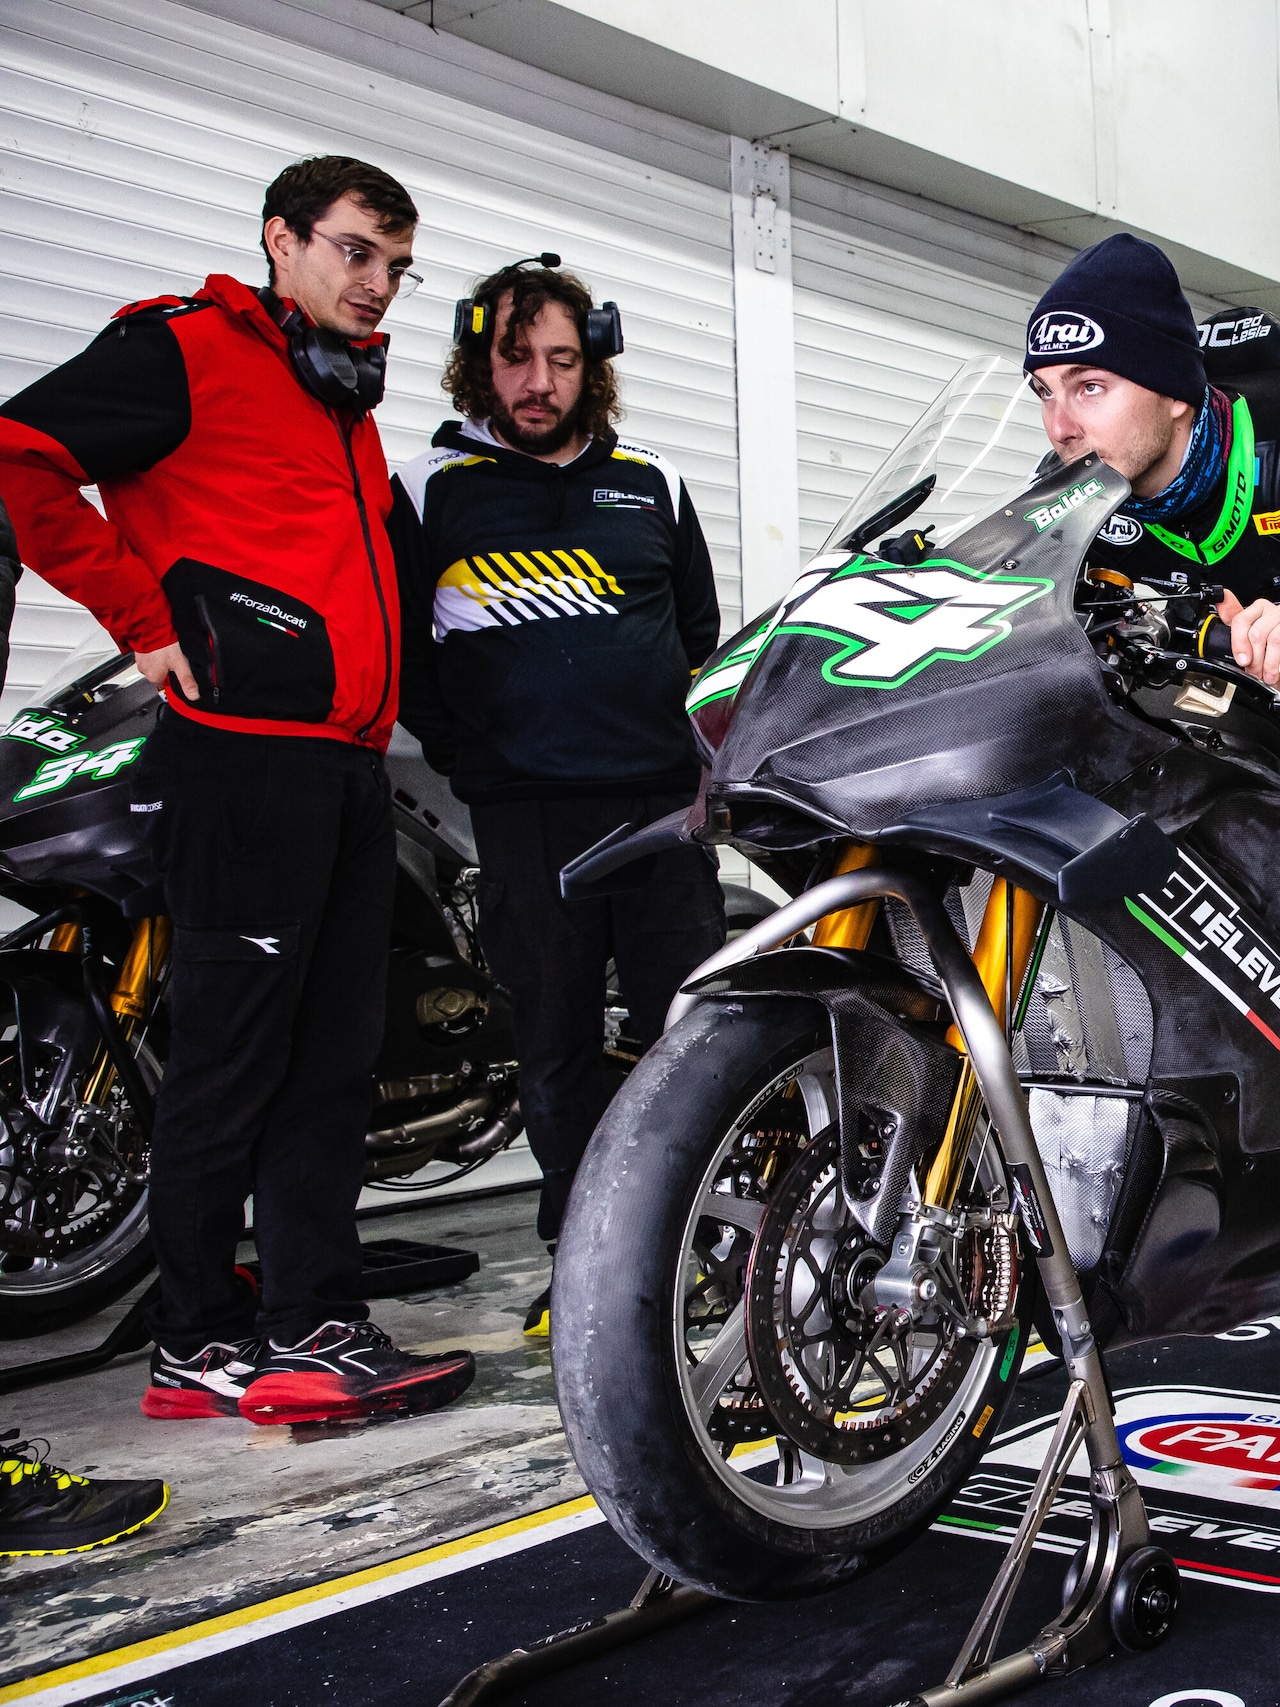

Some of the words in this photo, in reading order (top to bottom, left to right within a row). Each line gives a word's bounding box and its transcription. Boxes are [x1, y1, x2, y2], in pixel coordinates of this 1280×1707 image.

[1034, 317, 1093, 343] Arai
[1233, 313, 1264, 332] red
[1025, 479, 1105, 531] Balda
[1211, 470, 1248, 555] GIMOTO
[229, 592, 307, 630] #ForzaDucati
[0, 713, 82, 753] lda
[13, 737, 146, 802] 34
[936, 1416, 965, 1457] RACING
